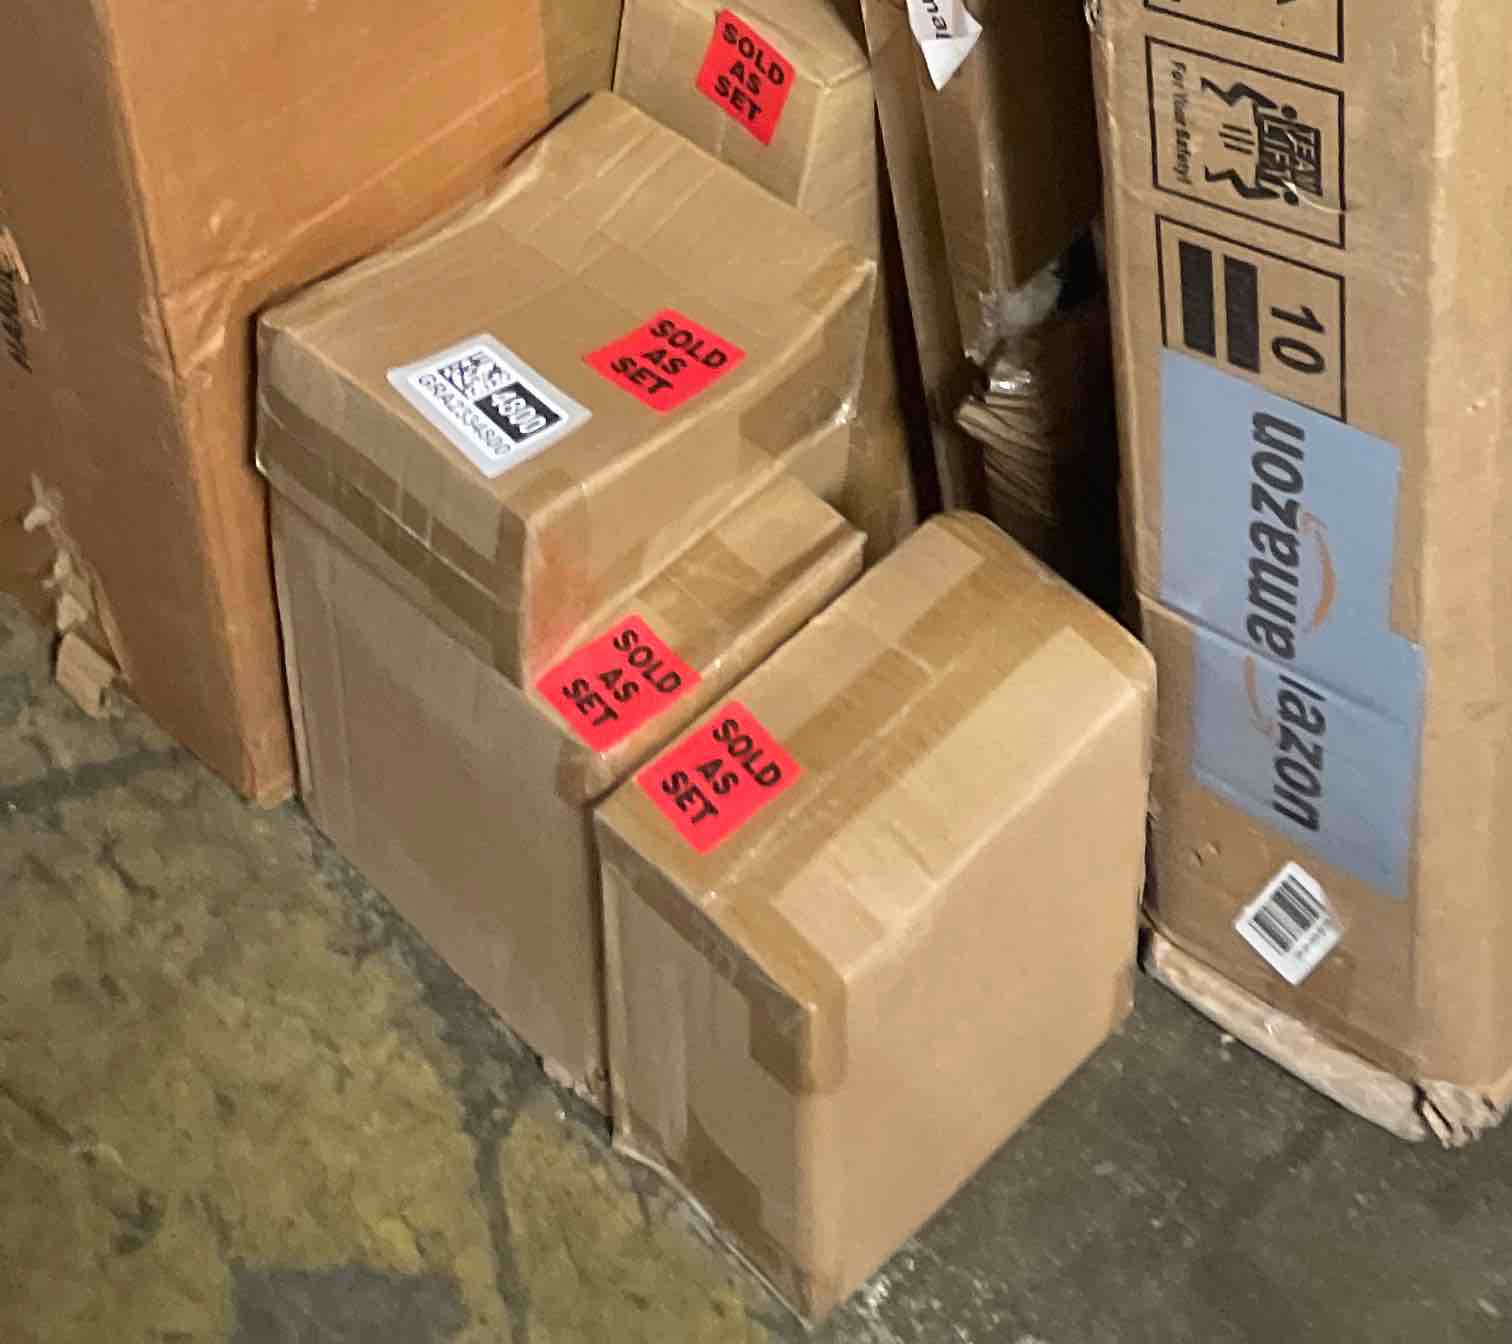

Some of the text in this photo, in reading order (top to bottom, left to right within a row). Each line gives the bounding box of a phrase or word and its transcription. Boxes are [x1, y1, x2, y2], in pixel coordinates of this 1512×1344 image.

[721, 20, 786, 89] SOLD
[728, 58, 762, 97] AS
[713, 74, 764, 123] SET
[641, 348, 688, 376] AS
[649, 318, 730, 371] SOLD
[1269, 299, 1326, 377] 10
[609, 355, 674, 396] SET
[1246, 411, 1306, 661] amazon
[599, 667, 640, 704] AS
[612, 628, 683, 696] SOLD
[561, 677, 619, 730] SET
[696, 756, 739, 797] AS
[711, 717, 784, 790] SOLD
[1272, 674, 1328, 832] azon
[661, 769, 720, 827] SET
